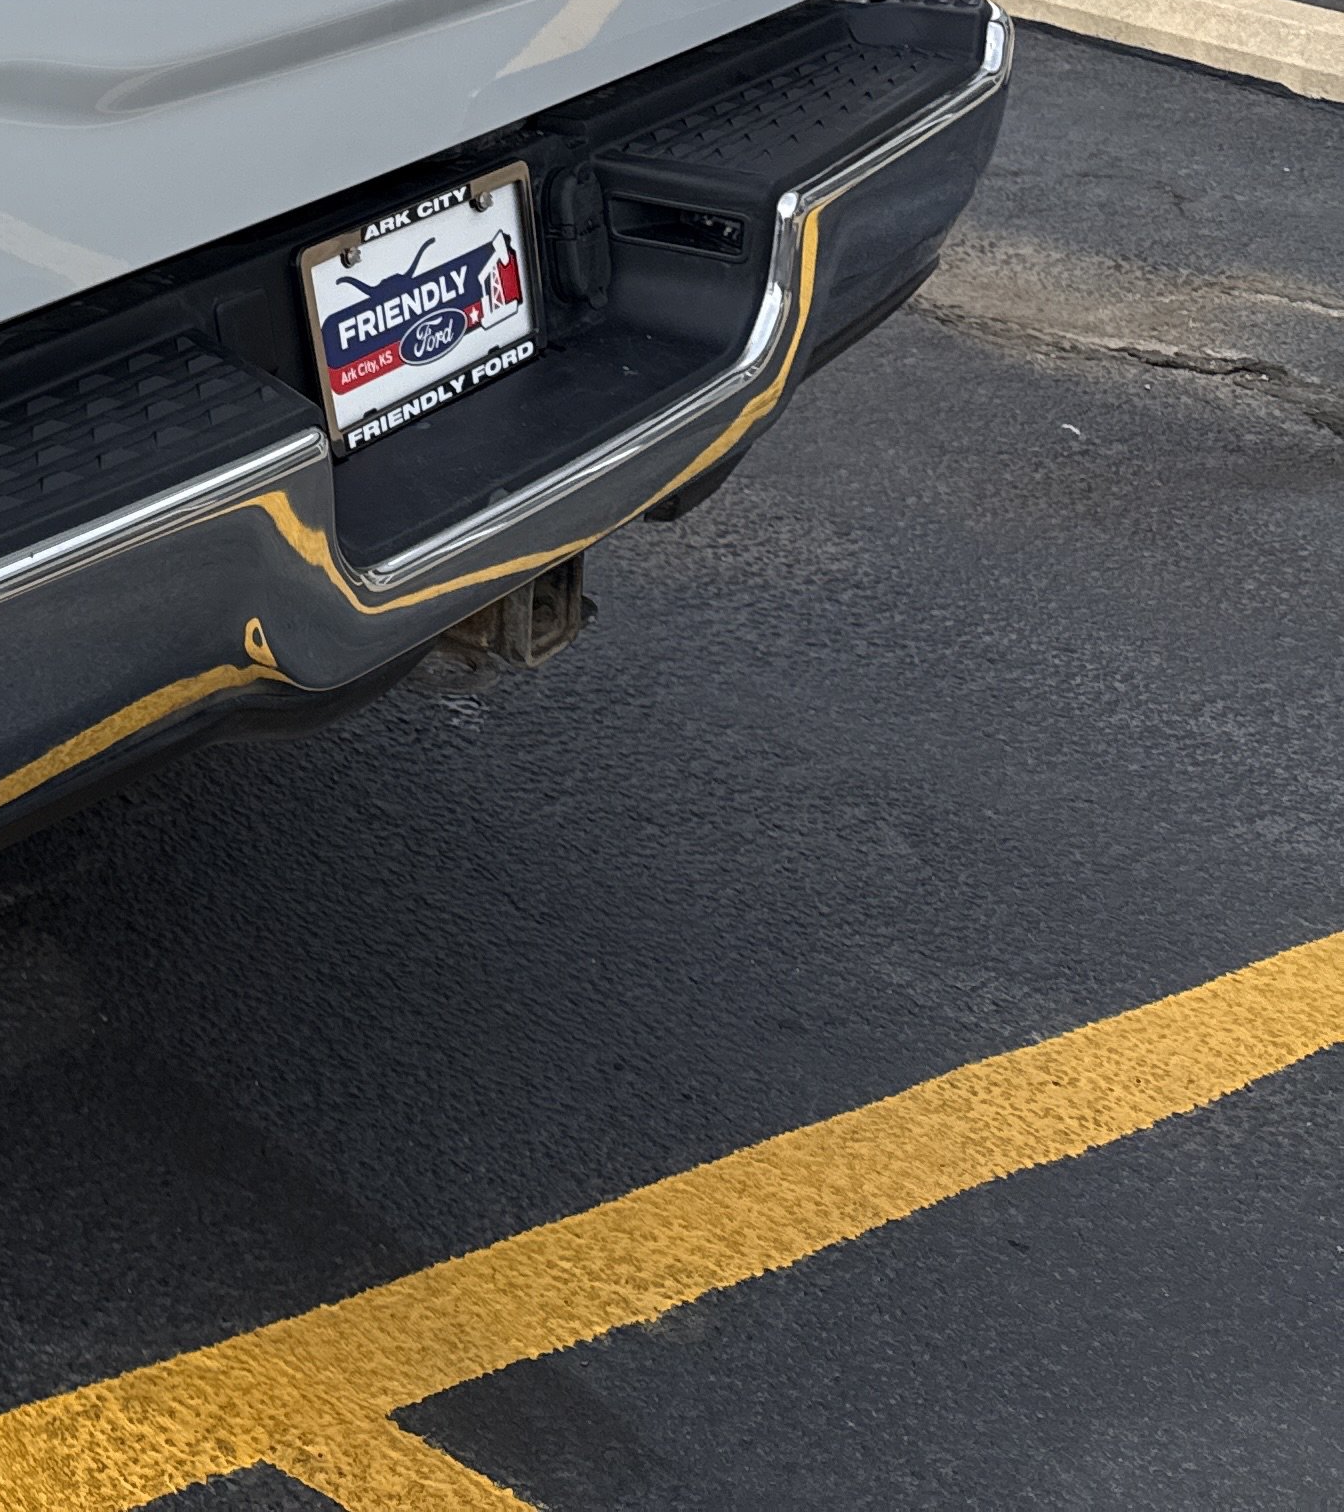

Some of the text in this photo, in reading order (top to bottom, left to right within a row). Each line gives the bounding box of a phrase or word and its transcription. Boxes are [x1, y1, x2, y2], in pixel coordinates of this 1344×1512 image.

[364, 186, 468, 241] ARK CITY
[337, 265, 468, 350] FRIENDLY
[413, 316, 454, 358] Ford
[341, 349, 394, 386] Ark City, KS
[348, 340, 535, 449] FRIENDLY FORD
